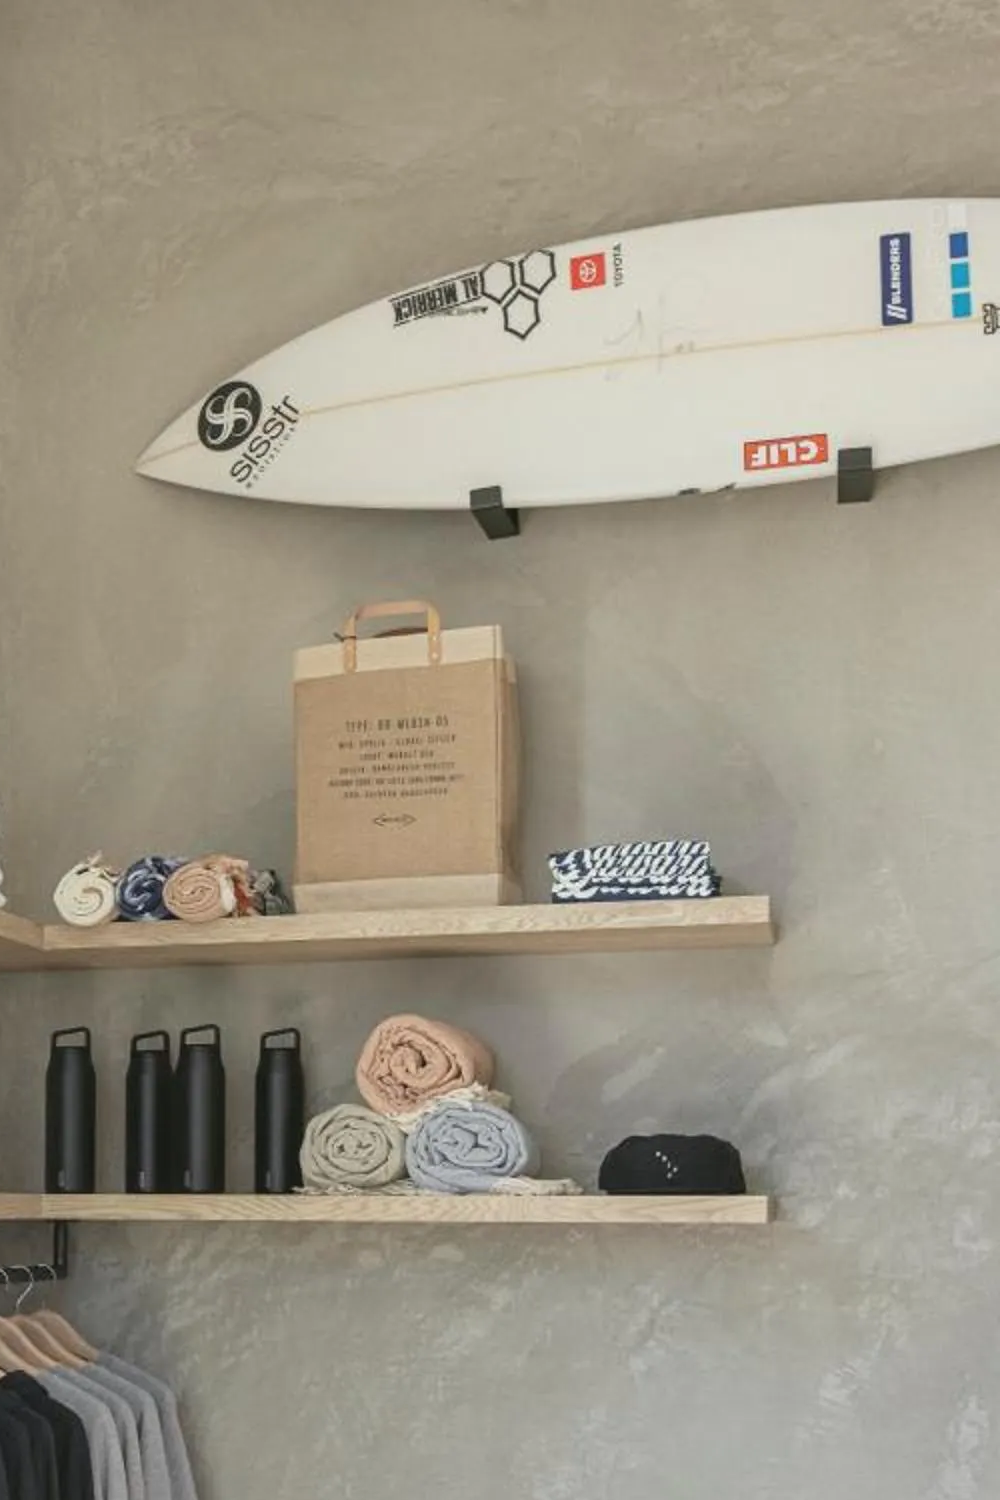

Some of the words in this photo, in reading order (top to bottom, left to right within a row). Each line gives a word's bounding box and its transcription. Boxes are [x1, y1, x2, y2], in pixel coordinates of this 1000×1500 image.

[612, 243, 624, 287] TOYOTA
[889, 238, 902, 304] BLENDERS
[392, 281, 458, 322] MERRICK
[464, 276, 480, 299] AL
[751, 440, 819, 467] CLIF
